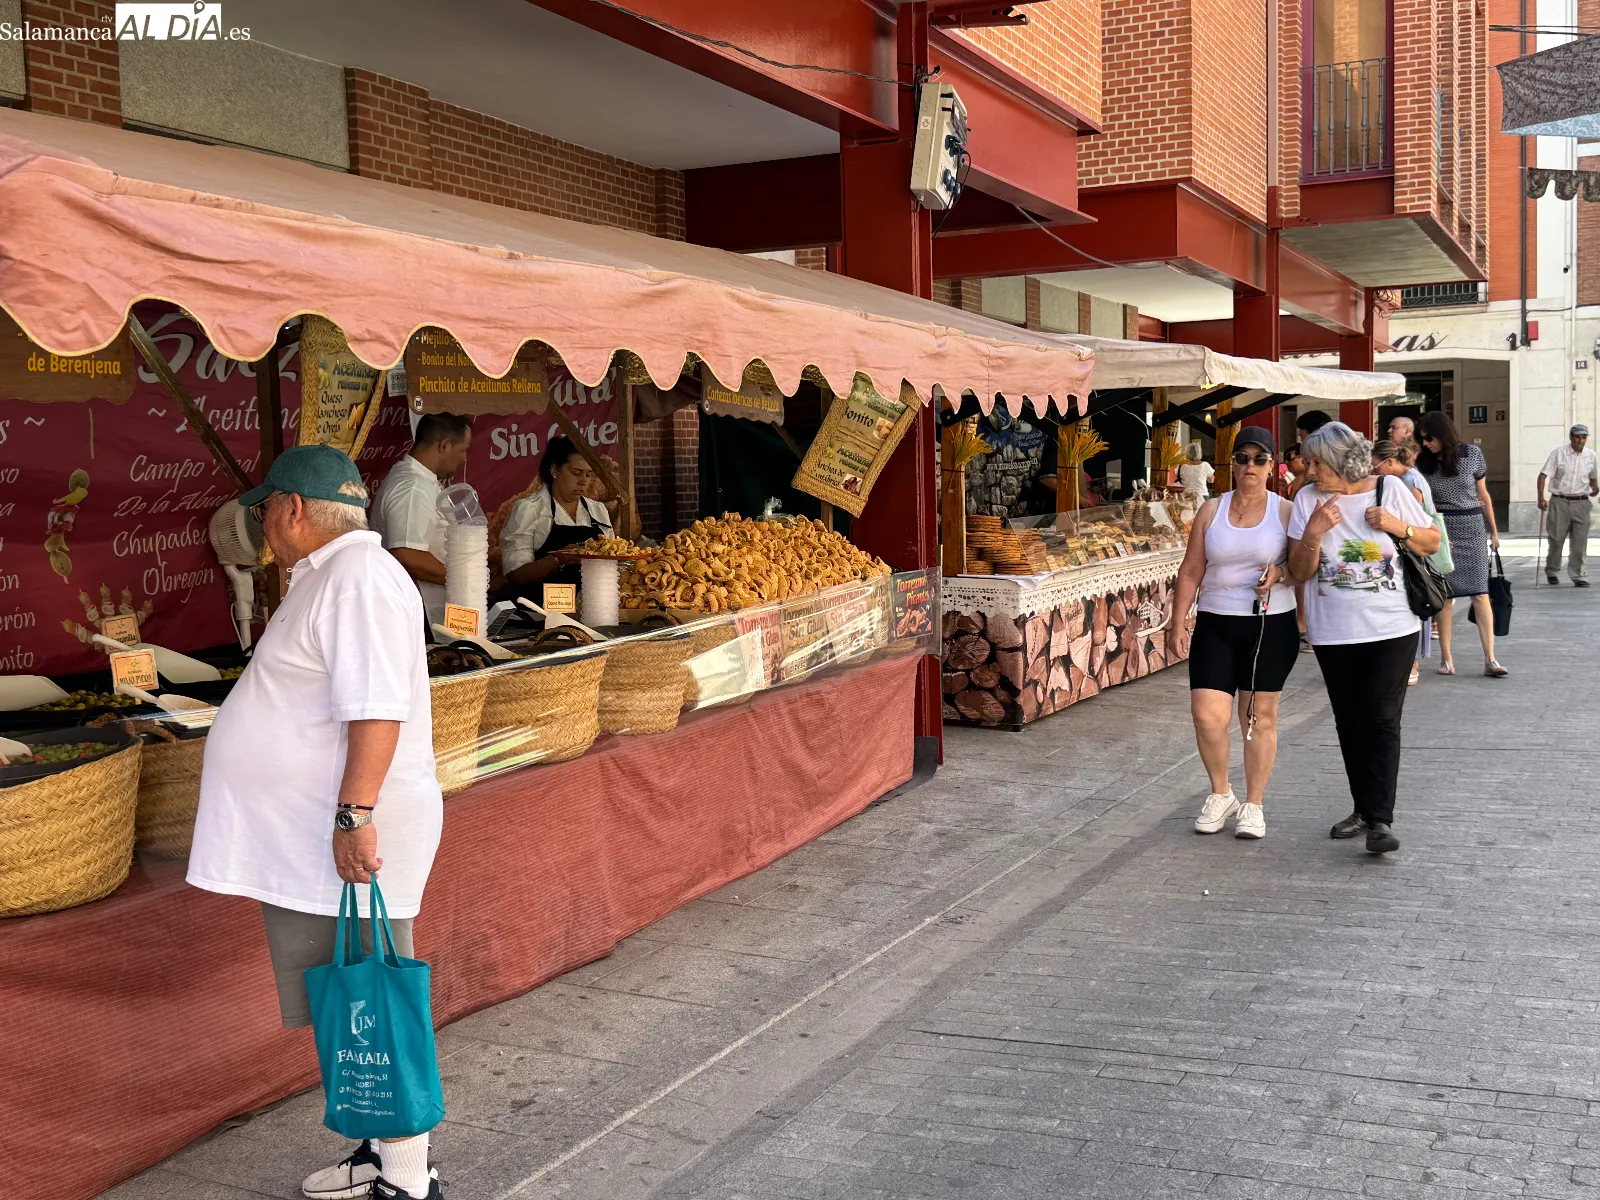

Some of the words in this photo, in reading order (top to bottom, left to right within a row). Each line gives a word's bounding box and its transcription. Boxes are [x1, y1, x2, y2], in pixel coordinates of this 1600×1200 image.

[27, 352, 45, 372] de
[50, 353, 122, 379] Berenjena
[321, 390, 343, 405] Queso
[419, 375, 456, 393] Pinchito
[458, 376, 469, 393] de
[470, 377, 511, 393] Aceitunas
[490, 423, 540, 461] Sin
[130, 454, 204, 493] Campo
[113, 496, 147, 518] De
[171, 484, 239, 513] Abuel
[143, 561, 215, 604] Obregón
[357, 1015, 376, 1033] JM
